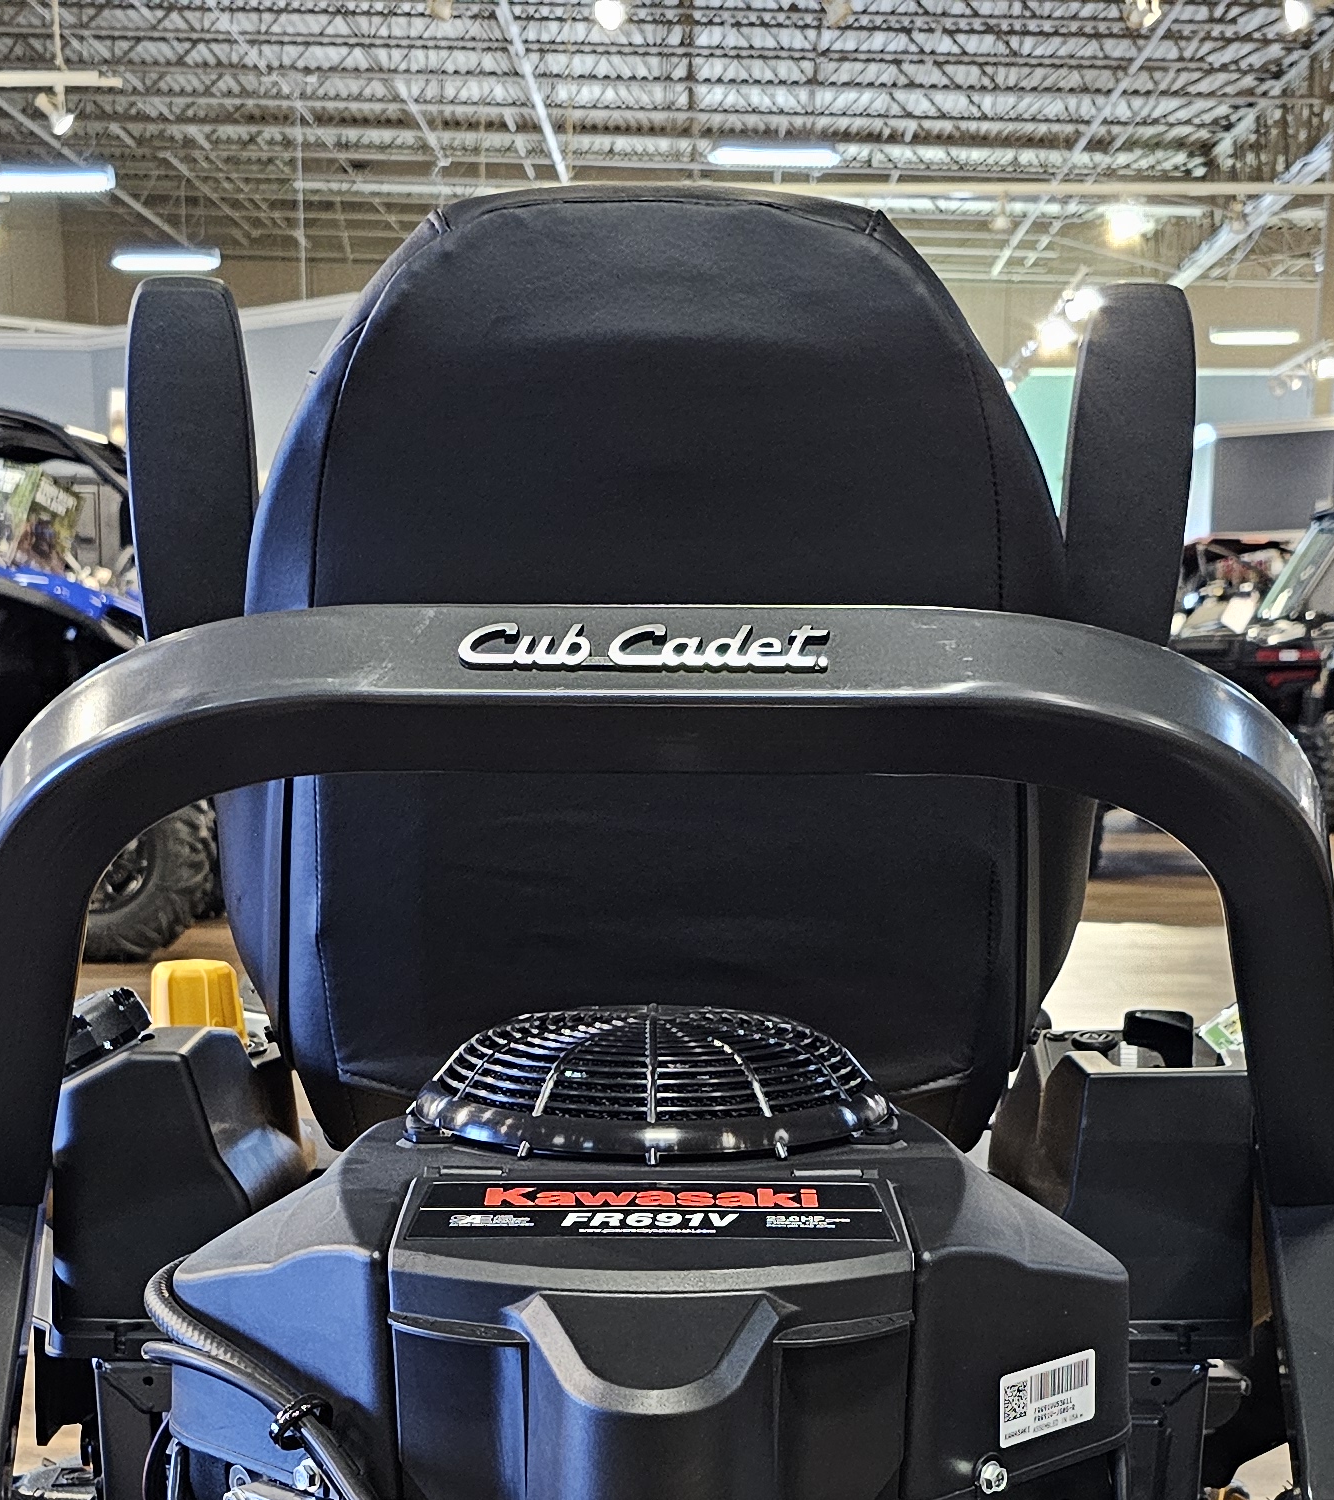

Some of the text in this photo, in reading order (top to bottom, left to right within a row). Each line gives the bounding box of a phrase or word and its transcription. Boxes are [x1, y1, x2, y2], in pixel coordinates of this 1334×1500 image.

[457, 621, 830, 673] Cub Cadet
[483, 1187, 818, 1208] Kawasaki
[560, 1211, 740, 1227] FR691V
